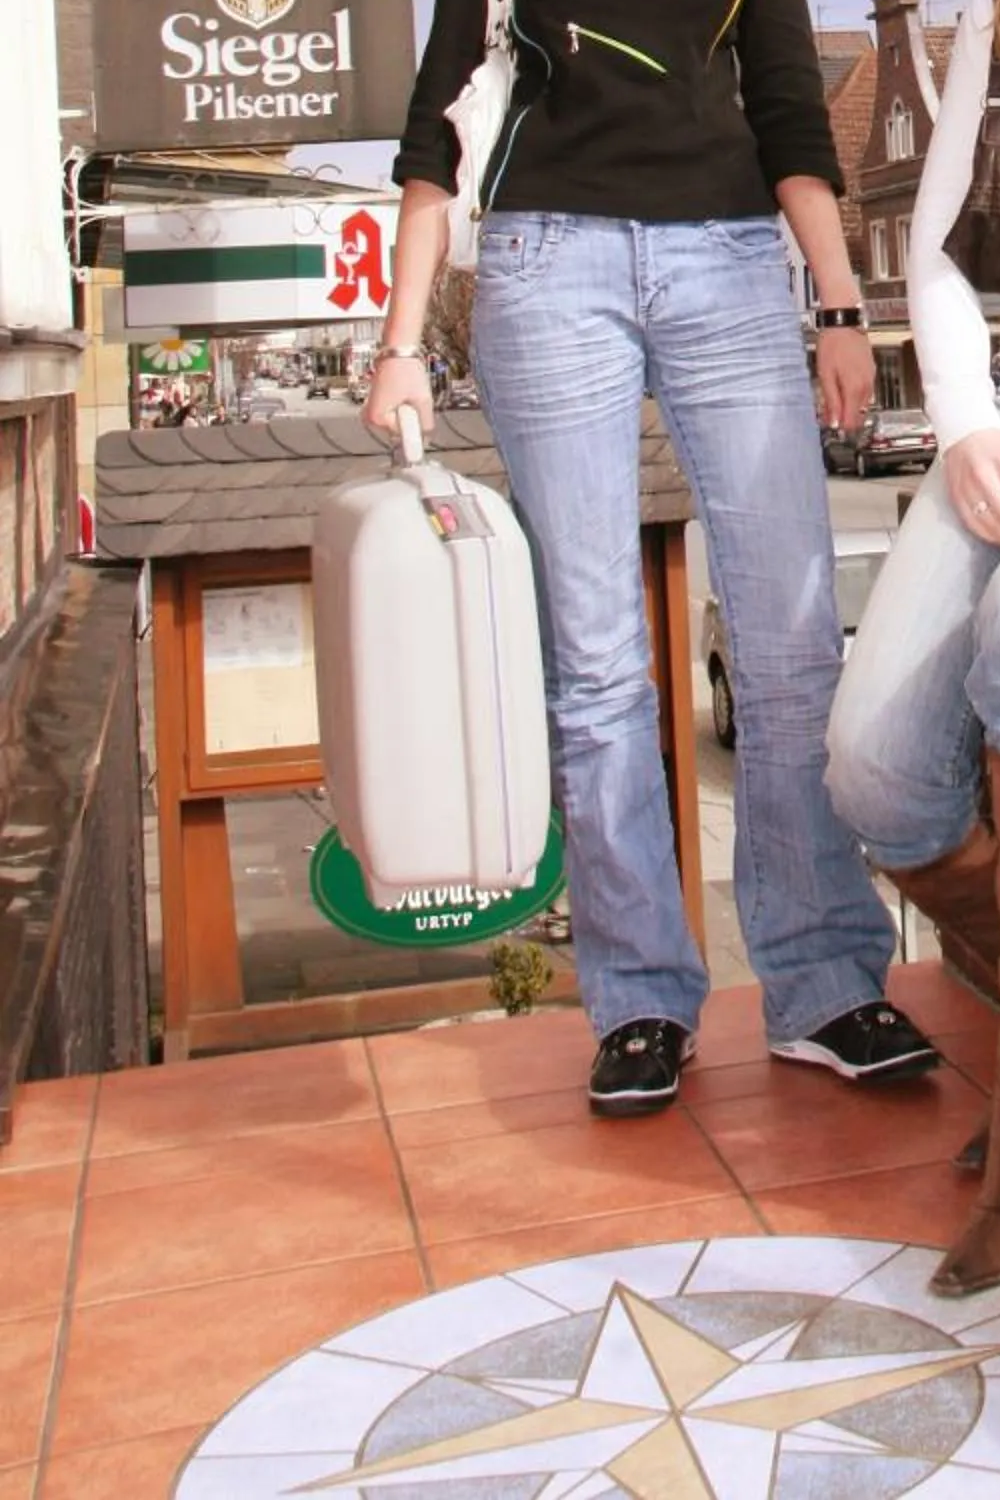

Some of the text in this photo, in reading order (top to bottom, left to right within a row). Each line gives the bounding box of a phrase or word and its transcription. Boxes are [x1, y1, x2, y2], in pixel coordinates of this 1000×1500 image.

[160, 8, 353, 87] Siegel
[183, 82, 340, 122] Pilsener
[415, 911, 473, 931] URTYP
